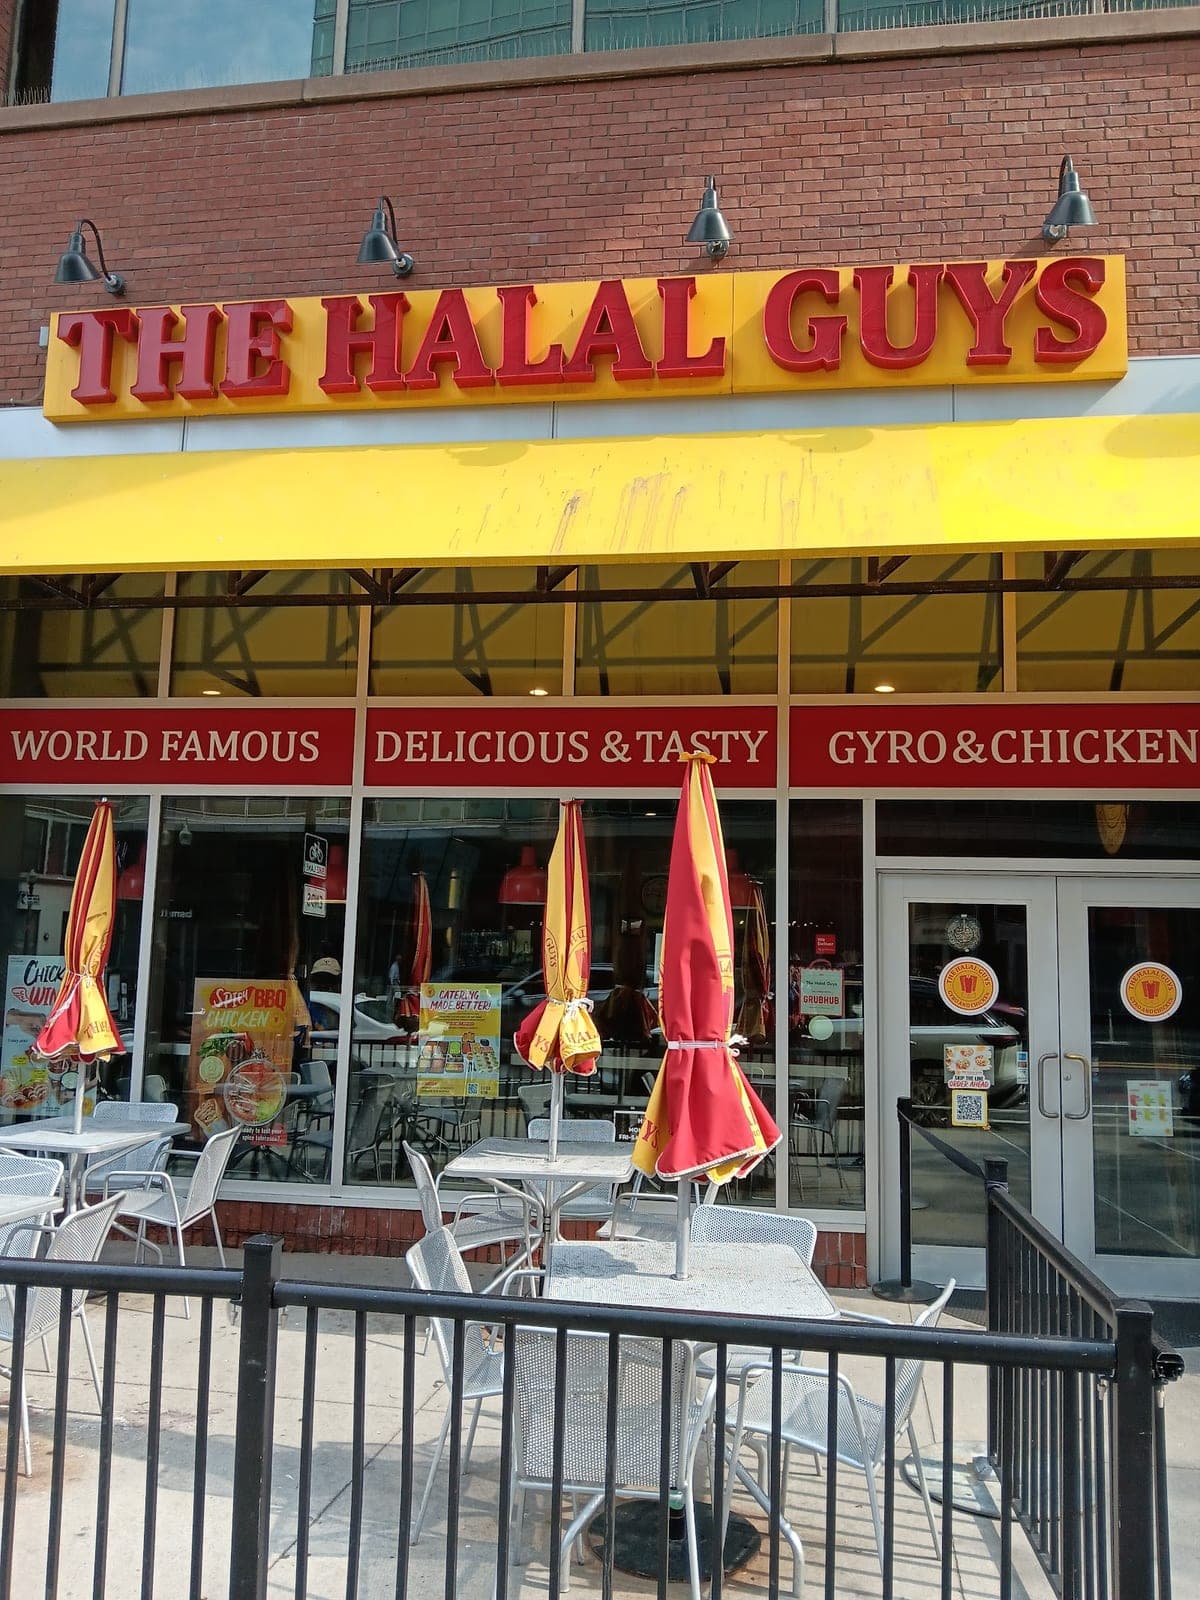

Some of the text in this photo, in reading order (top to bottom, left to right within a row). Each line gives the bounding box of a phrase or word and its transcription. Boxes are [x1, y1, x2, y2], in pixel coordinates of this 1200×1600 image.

[57, 257, 1107, 405] THE HALAL GUYS
[11, 730, 320, 762] WORLD FAMOUS
[375, 730, 589, 763] DELICIOUS
[955, 963, 978, 973] HALAL
[978, 968, 991, 987] GUYS
[1137, 969, 1160, 979] HALAL
[1160, 973, 1174, 991] GUYS
[254, 988, 286, 1012] BBQ
[430, 1000, 492, 1011] MADE BETTER!
[439, 990, 479, 1000] CATERING
[803, 995, 840, 1004] GRUBHUB
[206, 1010, 270, 1028] CHICKEN
